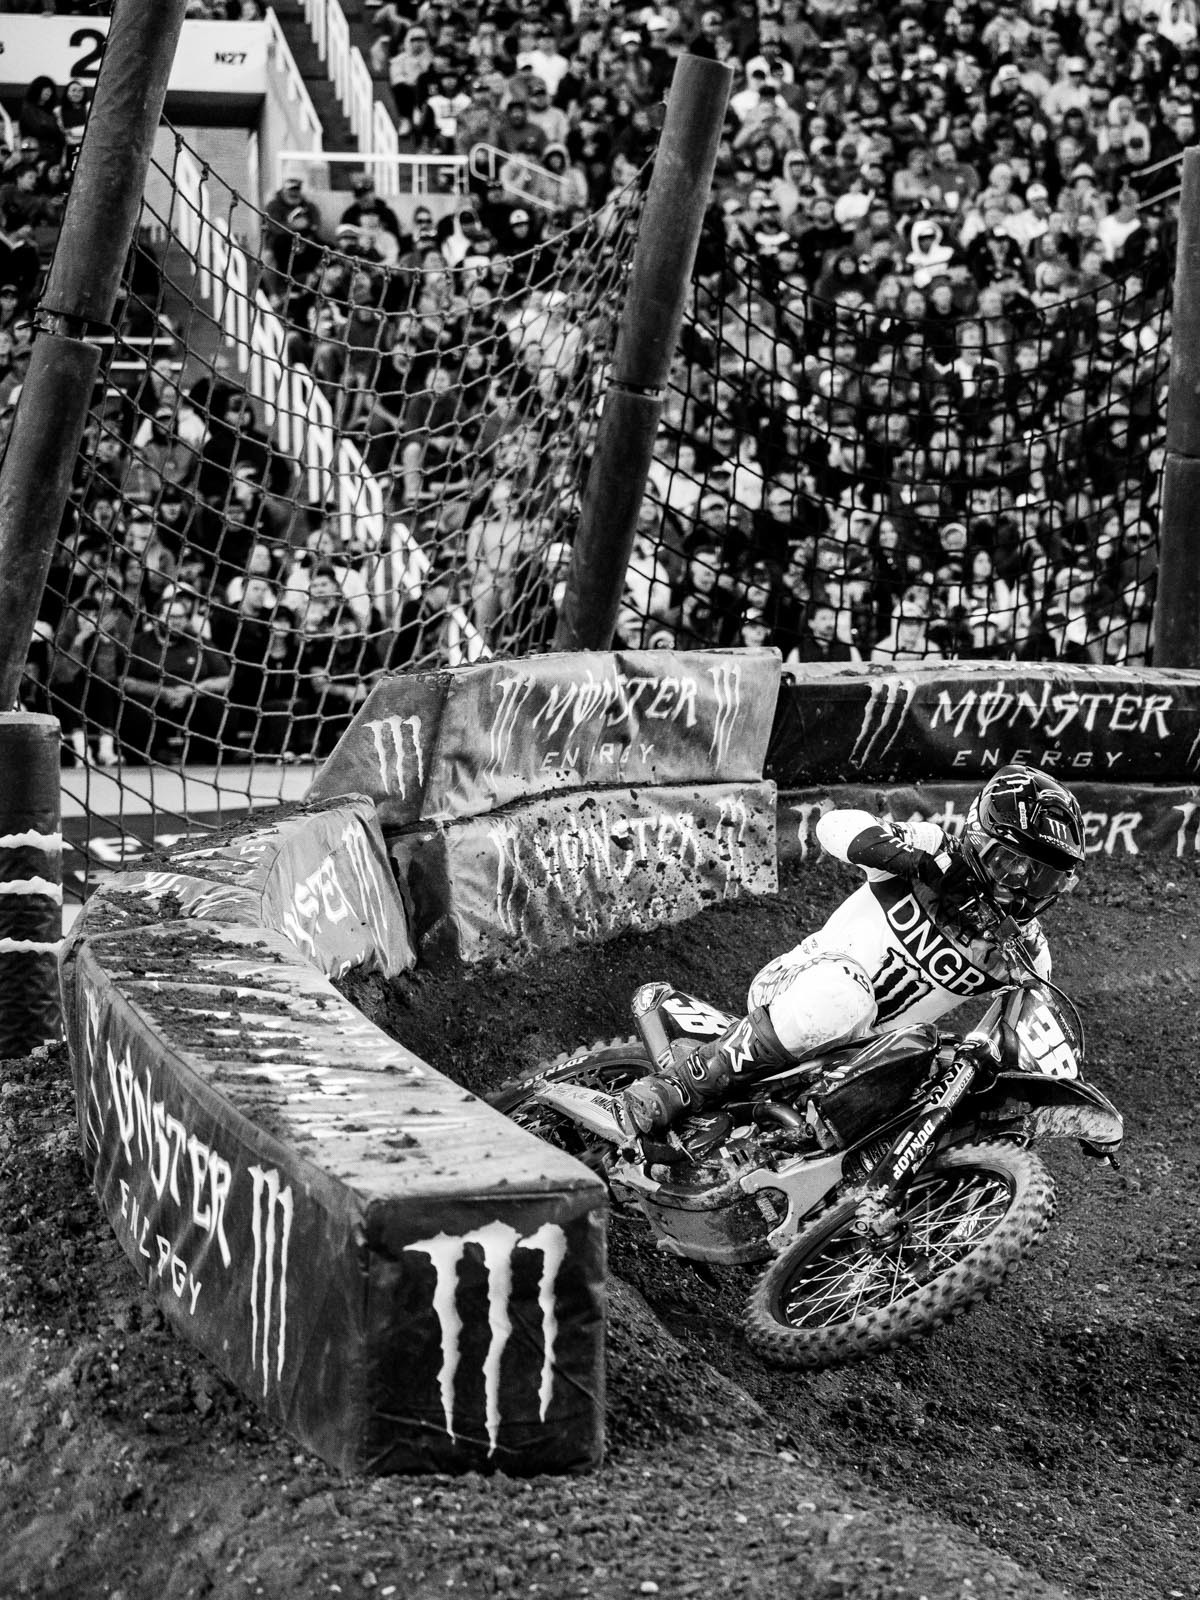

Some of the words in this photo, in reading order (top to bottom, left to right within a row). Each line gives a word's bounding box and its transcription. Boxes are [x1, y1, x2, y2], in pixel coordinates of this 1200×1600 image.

[214, 52, 248, 65] N27
[532, 663, 698, 739] MONSTER
[930, 680, 1174, 739] MONSTER
[539, 743, 655, 772] ENRGY
[952, 749, 1123, 768] ENERGY
[887, 892, 985, 996] DNGR
[893, 1119, 936, 1180] DUNLOP
